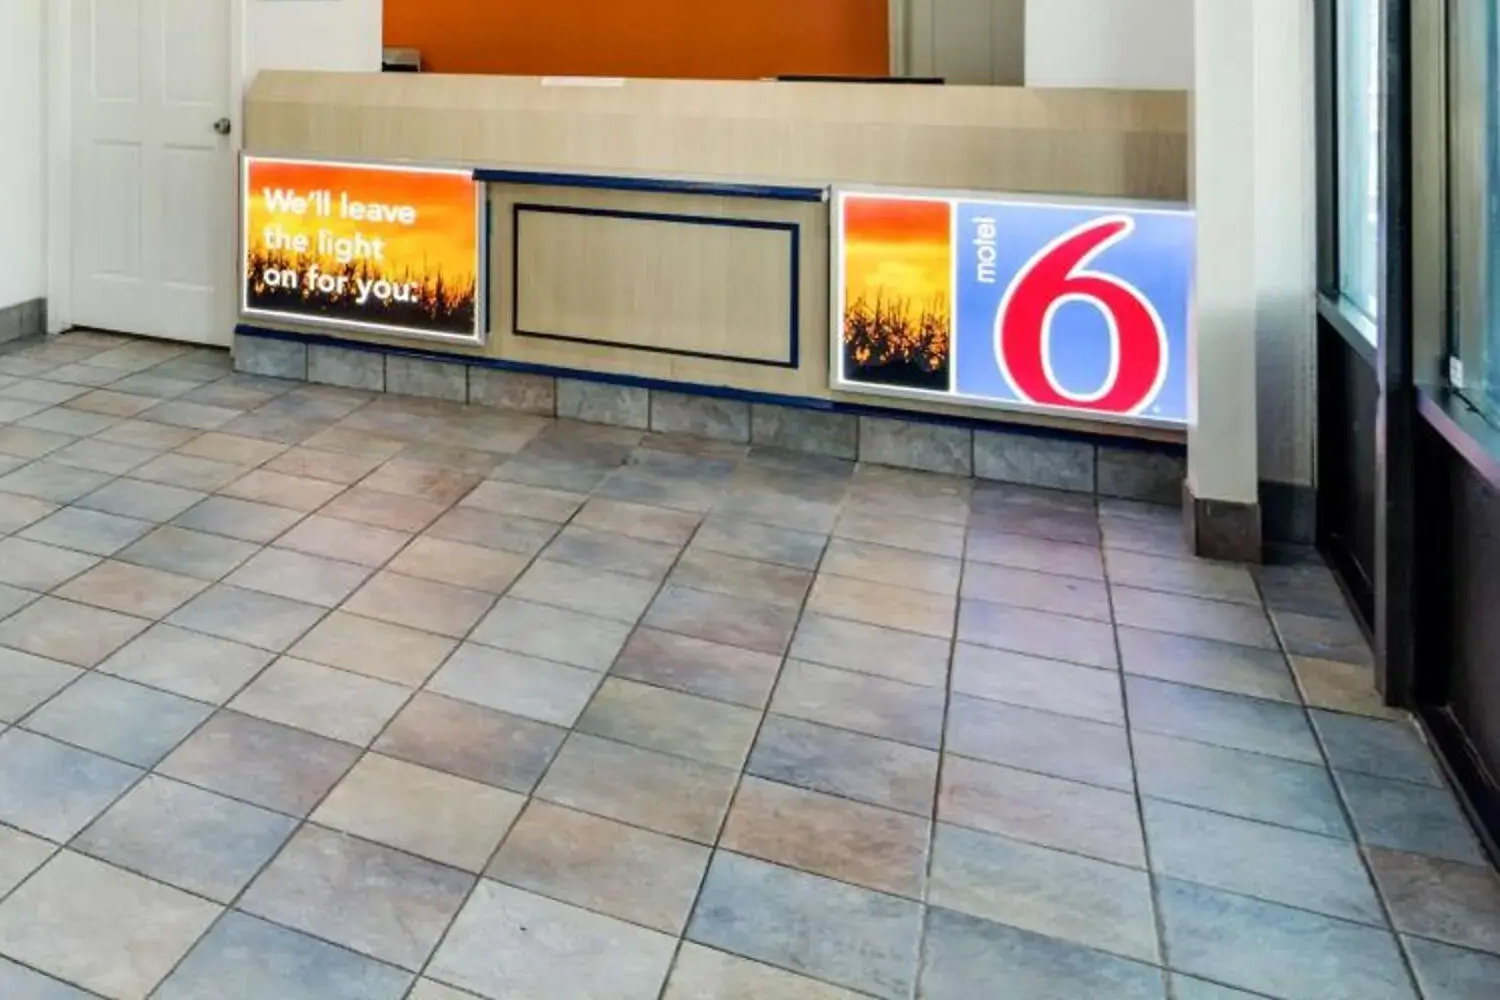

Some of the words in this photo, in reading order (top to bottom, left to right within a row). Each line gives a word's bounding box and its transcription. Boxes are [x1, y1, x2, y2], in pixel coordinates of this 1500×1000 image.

[263, 187, 331, 217] We'll
[340, 191, 417, 225] leave
[264, 224, 308, 253] the
[317, 228, 385, 264] light
[263, 267, 297, 289] on
[306, 264, 348, 294] for
[971, 216, 996, 284] motel
[993, 214, 1169, 415] 6
